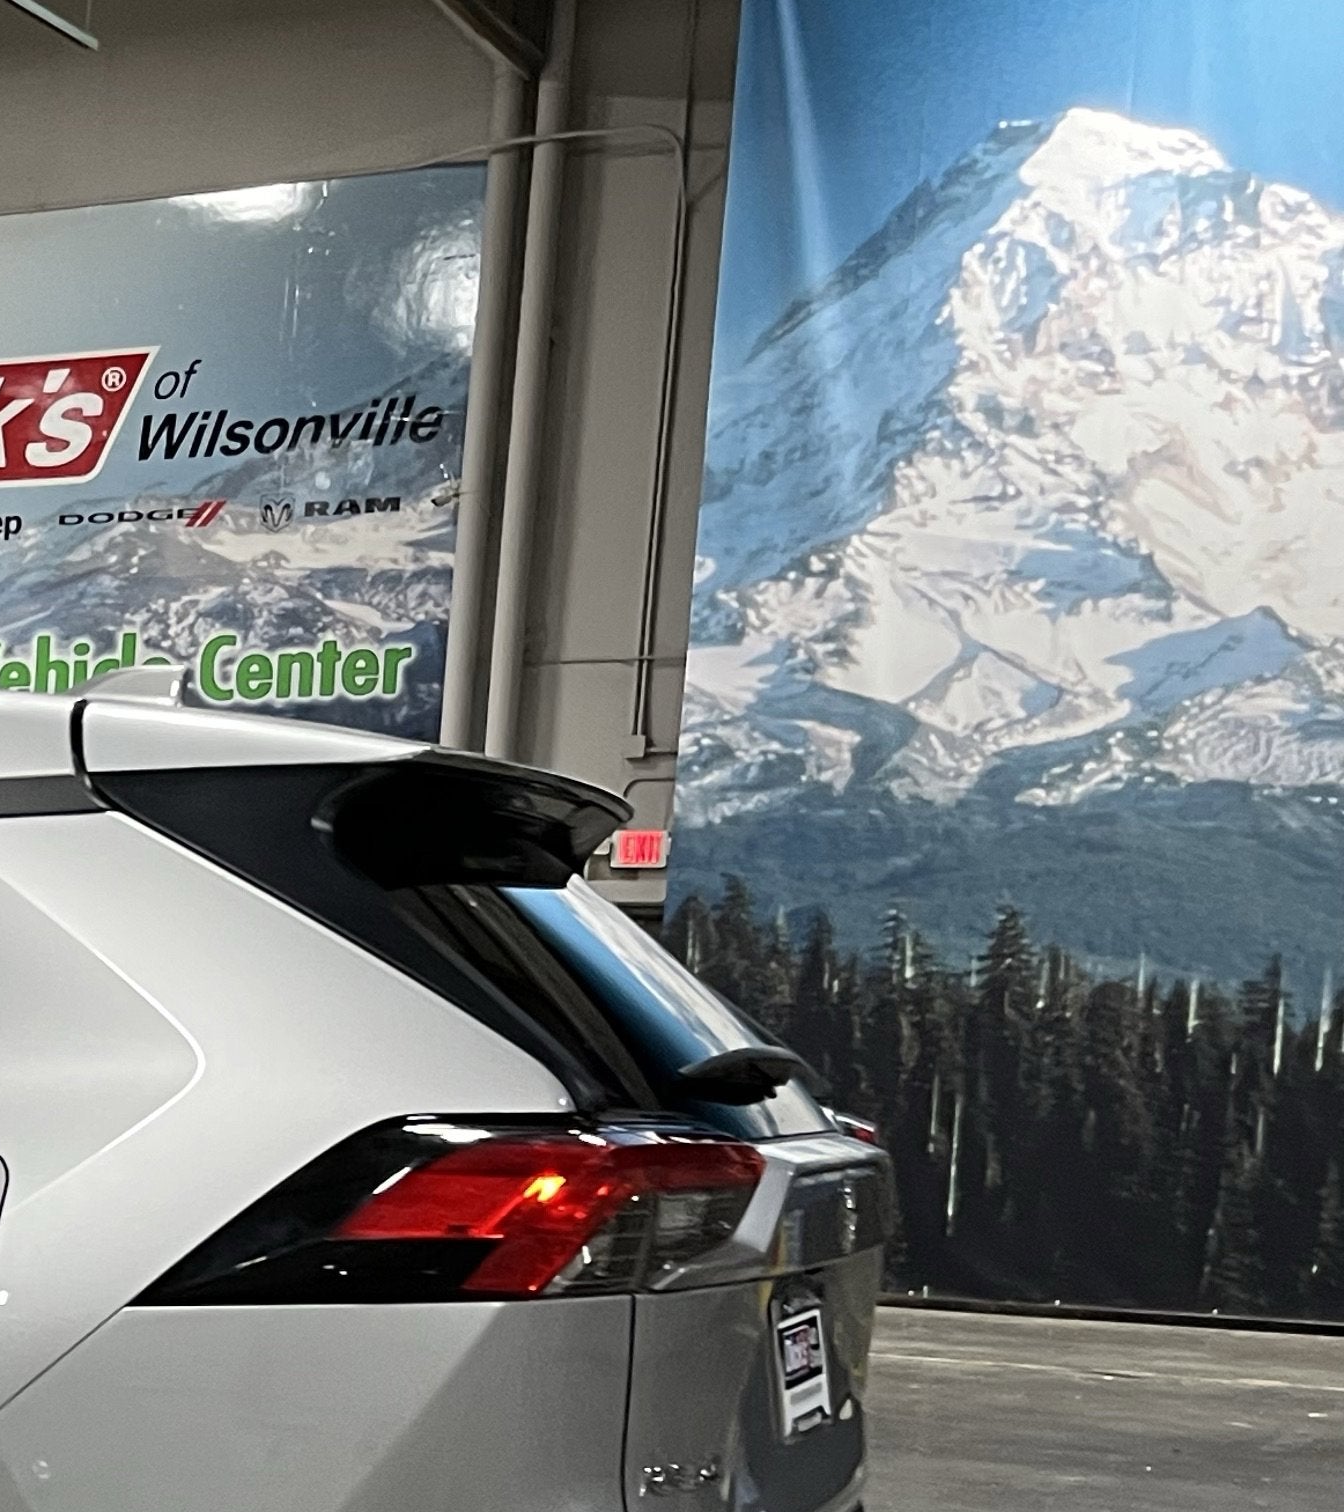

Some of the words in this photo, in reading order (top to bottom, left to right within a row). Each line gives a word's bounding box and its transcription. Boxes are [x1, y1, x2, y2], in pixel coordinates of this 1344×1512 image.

[153, 359, 203, 401] of
[138, 395, 444, 462] Wilsonville
[58, 508, 198, 526] DODGE
[304, 496, 401, 518] RAM
[199, 633, 413, 701] Center
[622, 835, 662, 863] EXIT
